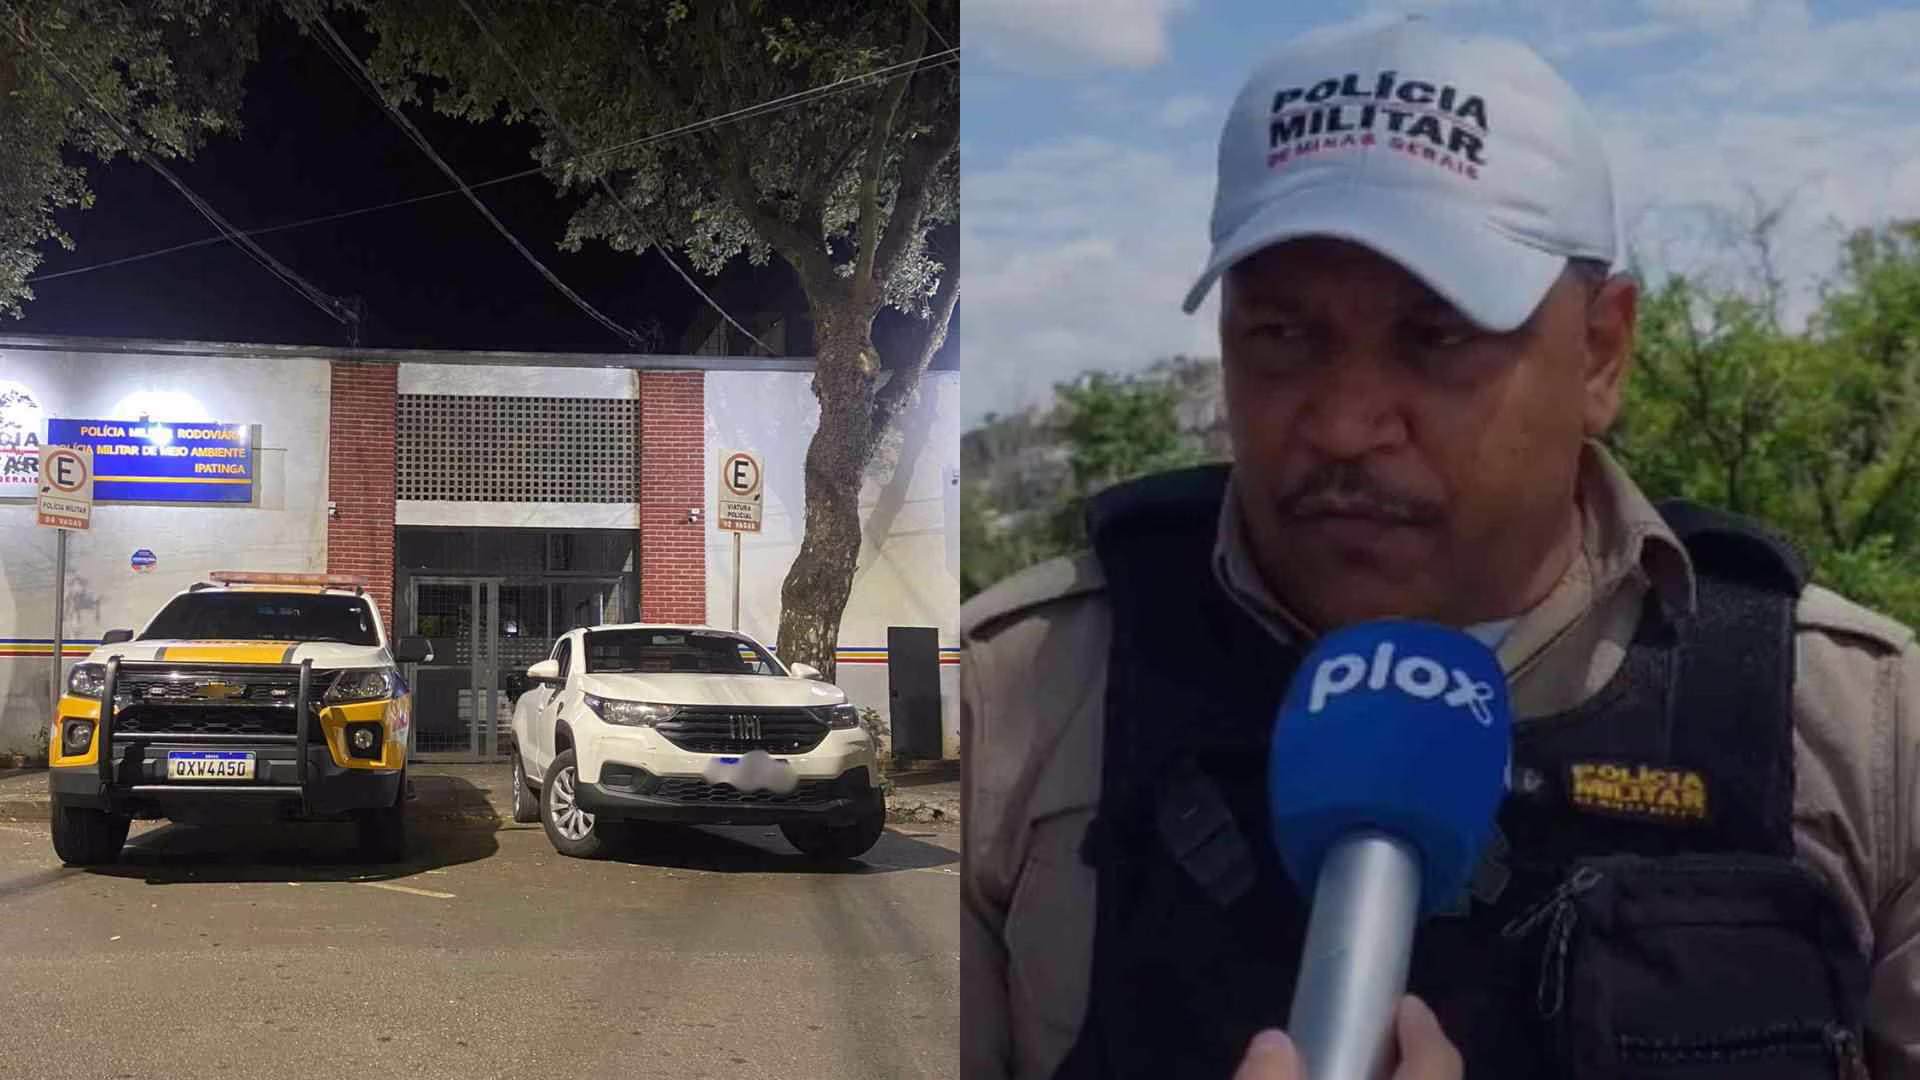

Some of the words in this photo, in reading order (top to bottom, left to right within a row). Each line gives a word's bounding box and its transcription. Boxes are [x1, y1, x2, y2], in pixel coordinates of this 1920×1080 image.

[1272, 70, 1489, 135] POLÍCIA
[1269, 104, 1488, 166] MILITAR
[1294, 132, 1377, 156] MINAS
[1391, 136, 1480, 181] GERAIS
[80, 424, 126, 438] POLÍCIA
[96, 444, 140, 456] MILITAR
[142, 446, 157, 457] DE
[191, 447, 246, 458] AMBIENTE
[57, 456, 75, 487] E
[194, 463, 246, 474] IPATINGA
[733, 460, 749, 489] E
[1308, 641, 1495, 727] plox
